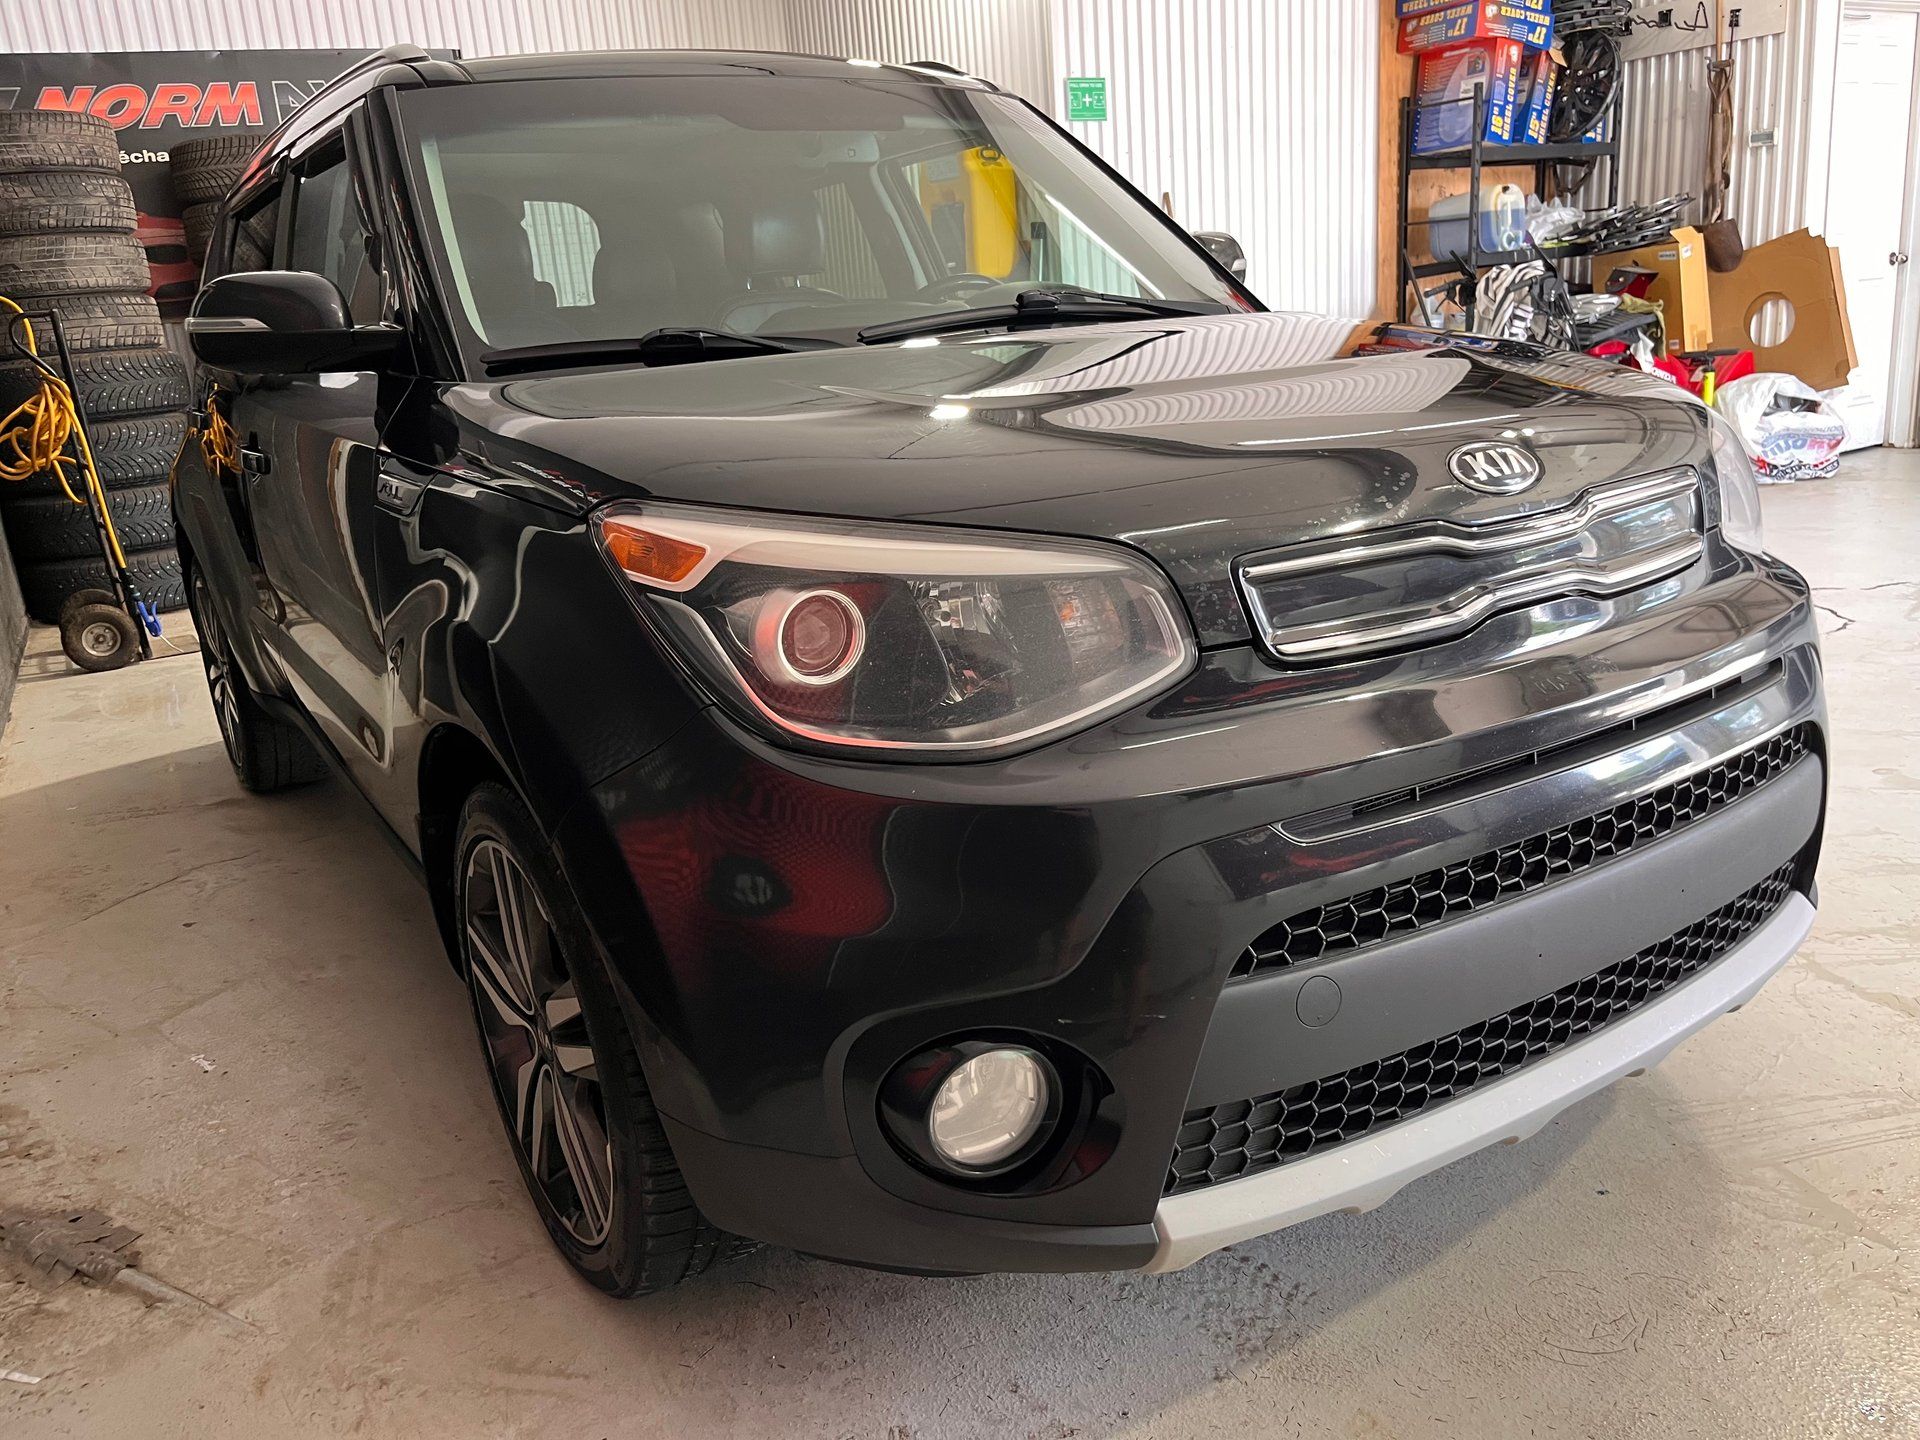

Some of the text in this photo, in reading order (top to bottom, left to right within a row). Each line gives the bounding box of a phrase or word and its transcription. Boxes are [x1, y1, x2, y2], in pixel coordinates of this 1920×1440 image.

[1420, 12, 1444, 26] COVER
[1501, 6, 1550, 26] WHEEL COVER
[34, 81, 264, 132] NORM
[1502, 67, 1517, 140] WHEEL COVER
[1544, 72, 1556, 107] COVER
[1462, 447, 1533, 482] KIA
